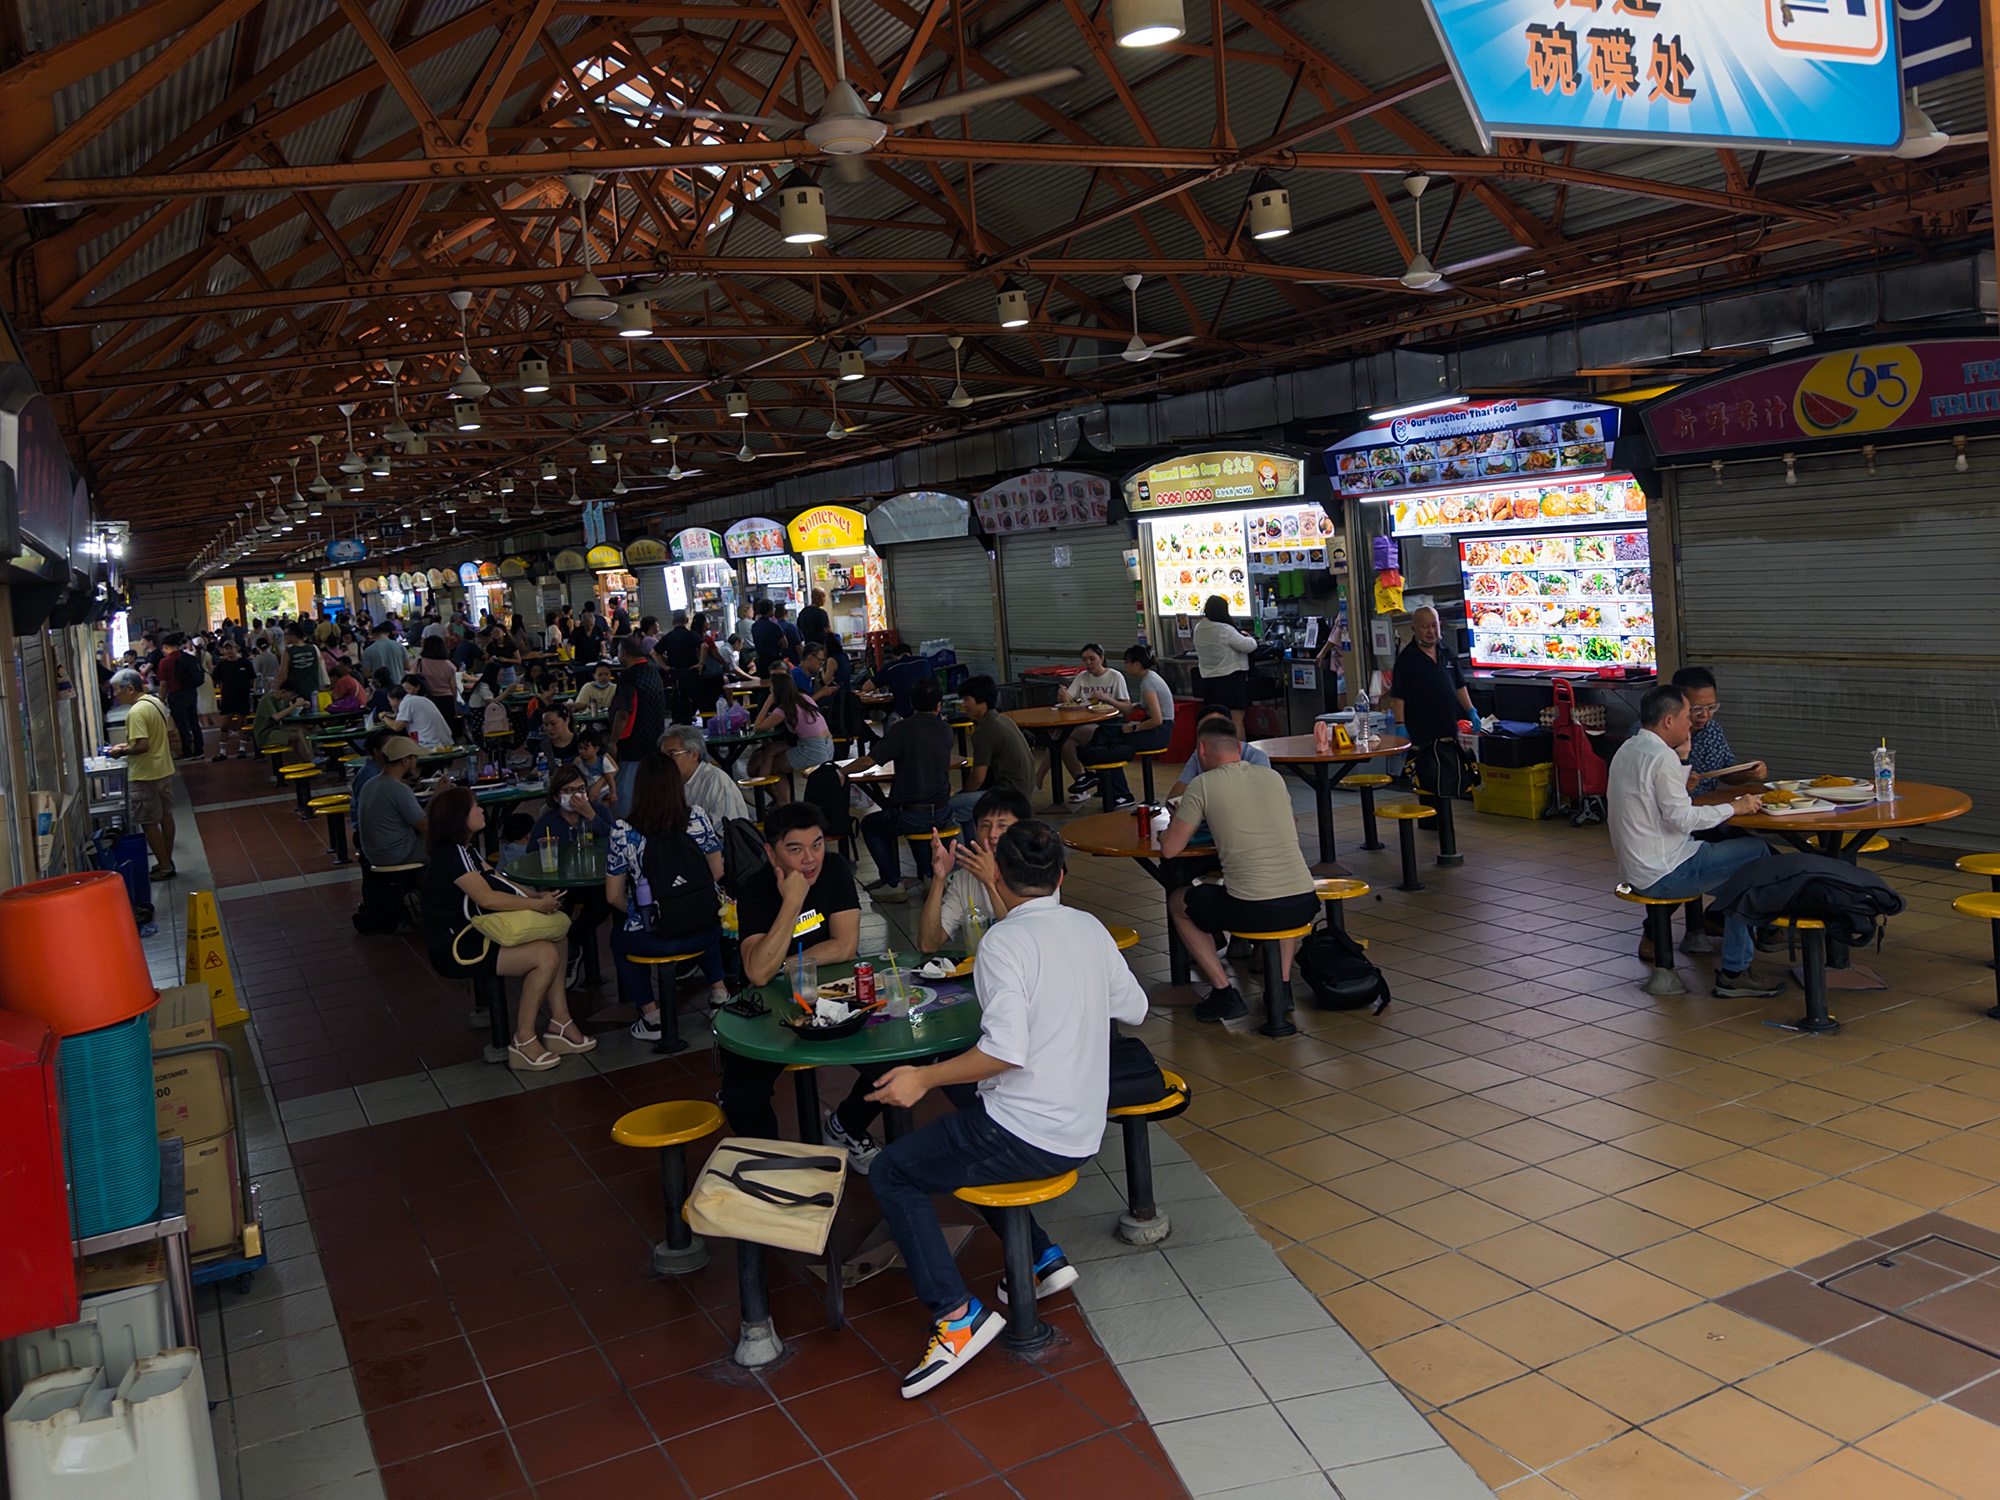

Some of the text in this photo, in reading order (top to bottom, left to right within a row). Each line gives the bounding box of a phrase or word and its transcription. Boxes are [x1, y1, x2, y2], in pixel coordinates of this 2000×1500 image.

[1525, 21, 1695, 104] 碗碟处
[1846, 353, 1908, 407] 65
[1410, 402, 1518, 428] Our Kitchen Thai Food
[798, 509, 852, 541] Somerset
[154, 1068, 189, 1083] CONTAINER
[154, 1086, 171, 1100] 00
